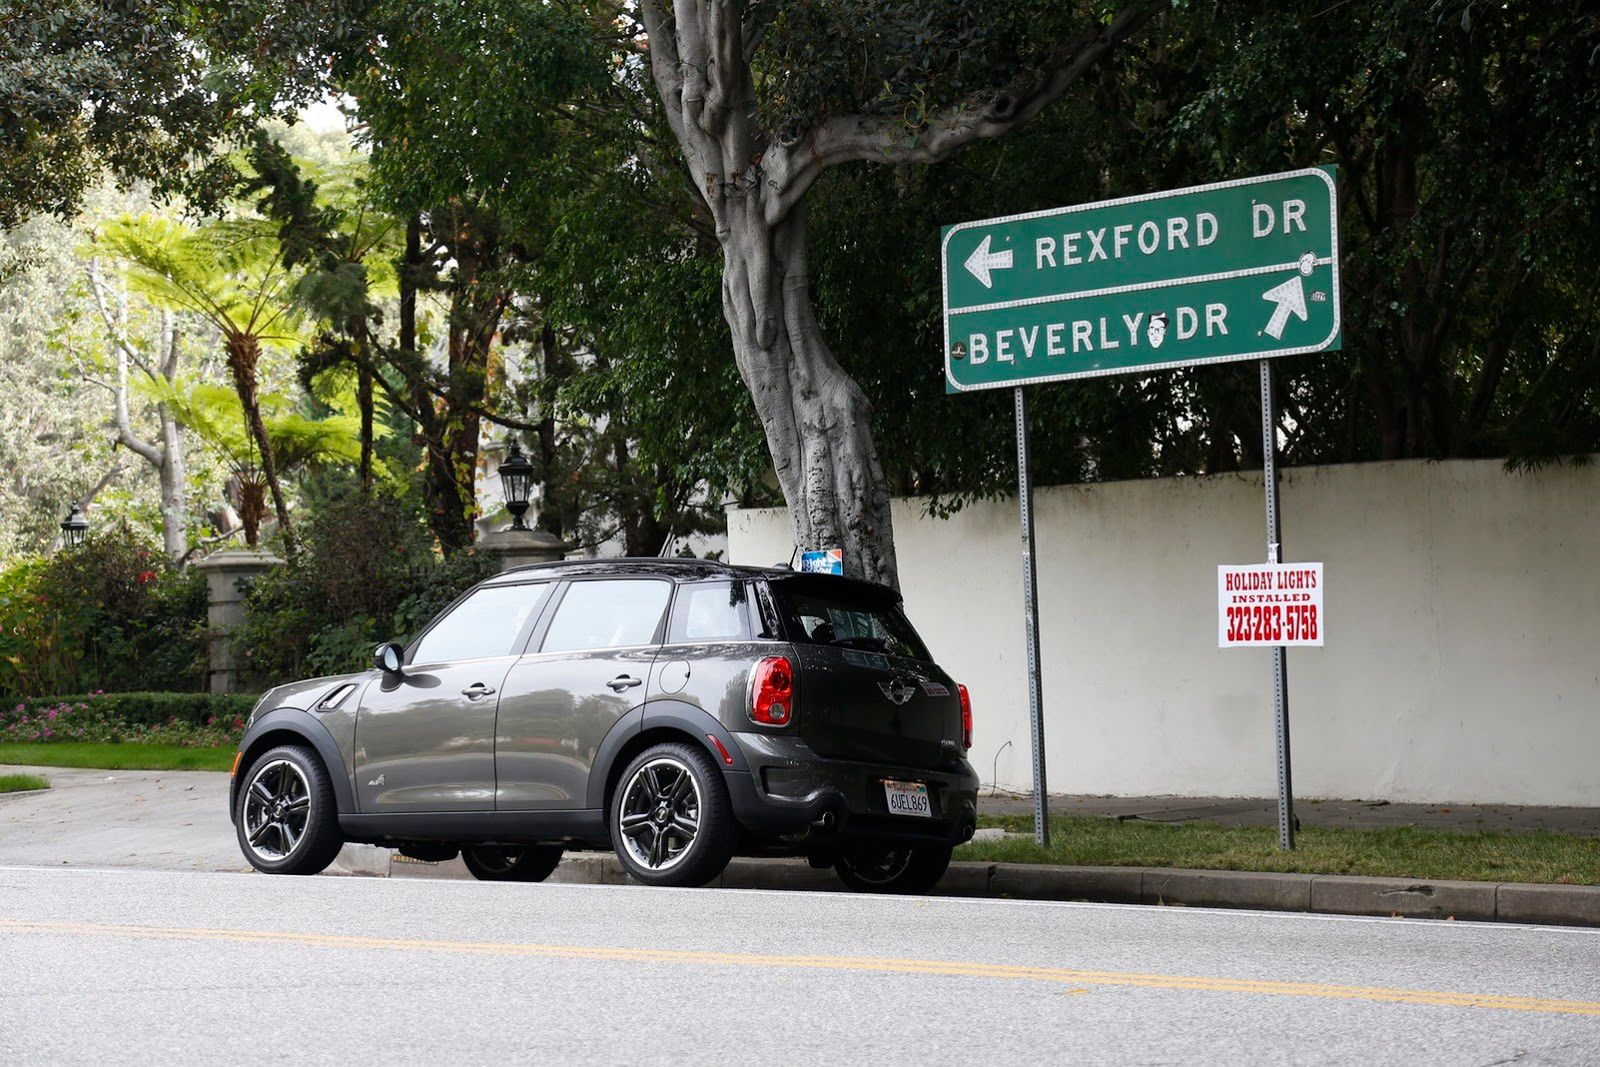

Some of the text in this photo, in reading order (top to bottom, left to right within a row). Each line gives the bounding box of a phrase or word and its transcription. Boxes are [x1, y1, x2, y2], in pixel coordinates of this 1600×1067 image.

[1036, 199, 1307, 270] REXFORD DR
[969, 303, 1229, 365] BEVERLY DR
[1226, 570, 1316, 591] HOLIDAY LIGHTS
[1232, 593, 1311, 603] INSTALLED
[1227, 604, 1318, 641] 323-283-5758
[891, 793, 927, 812] 6UEL869
